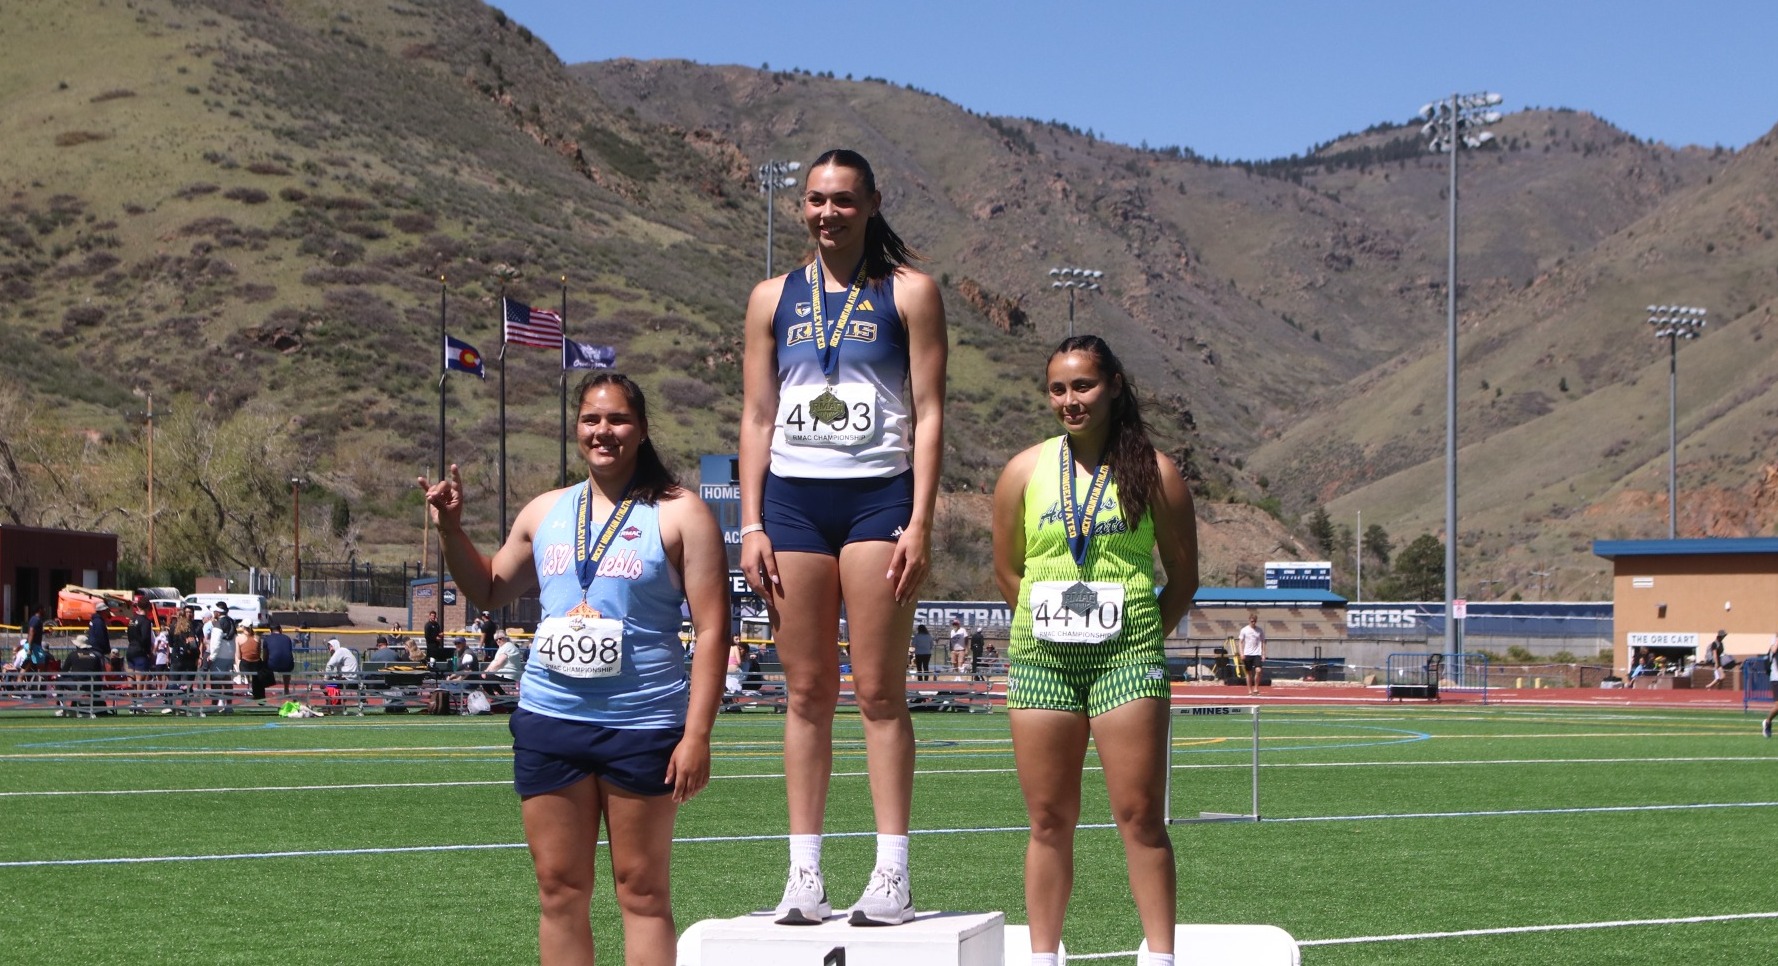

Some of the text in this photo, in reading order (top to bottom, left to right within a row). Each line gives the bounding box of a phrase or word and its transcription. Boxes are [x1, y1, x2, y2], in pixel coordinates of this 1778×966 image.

[787, 320, 878, 346] RS
[1095, 464, 1110, 488] ATHLETI
[705, 487, 740, 499] HOME
[577, 482, 588, 562] ERYTHINGELEVATED
[1093, 516, 1128, 535] ate
[542, 543, 643, 580] CSU ueblo
[1036, 600, 1118, 629] 4410
[1039, 630, 1112, 639] RMAC CHAMPIONSHIP
[1632, 635, 1694, 644] THE ORE CART
[538, 633, 618, 665] 4698
[562, 666, 613, 674] CHAMPIONSHIP
[1192, 707, 1230, 715] MINES
